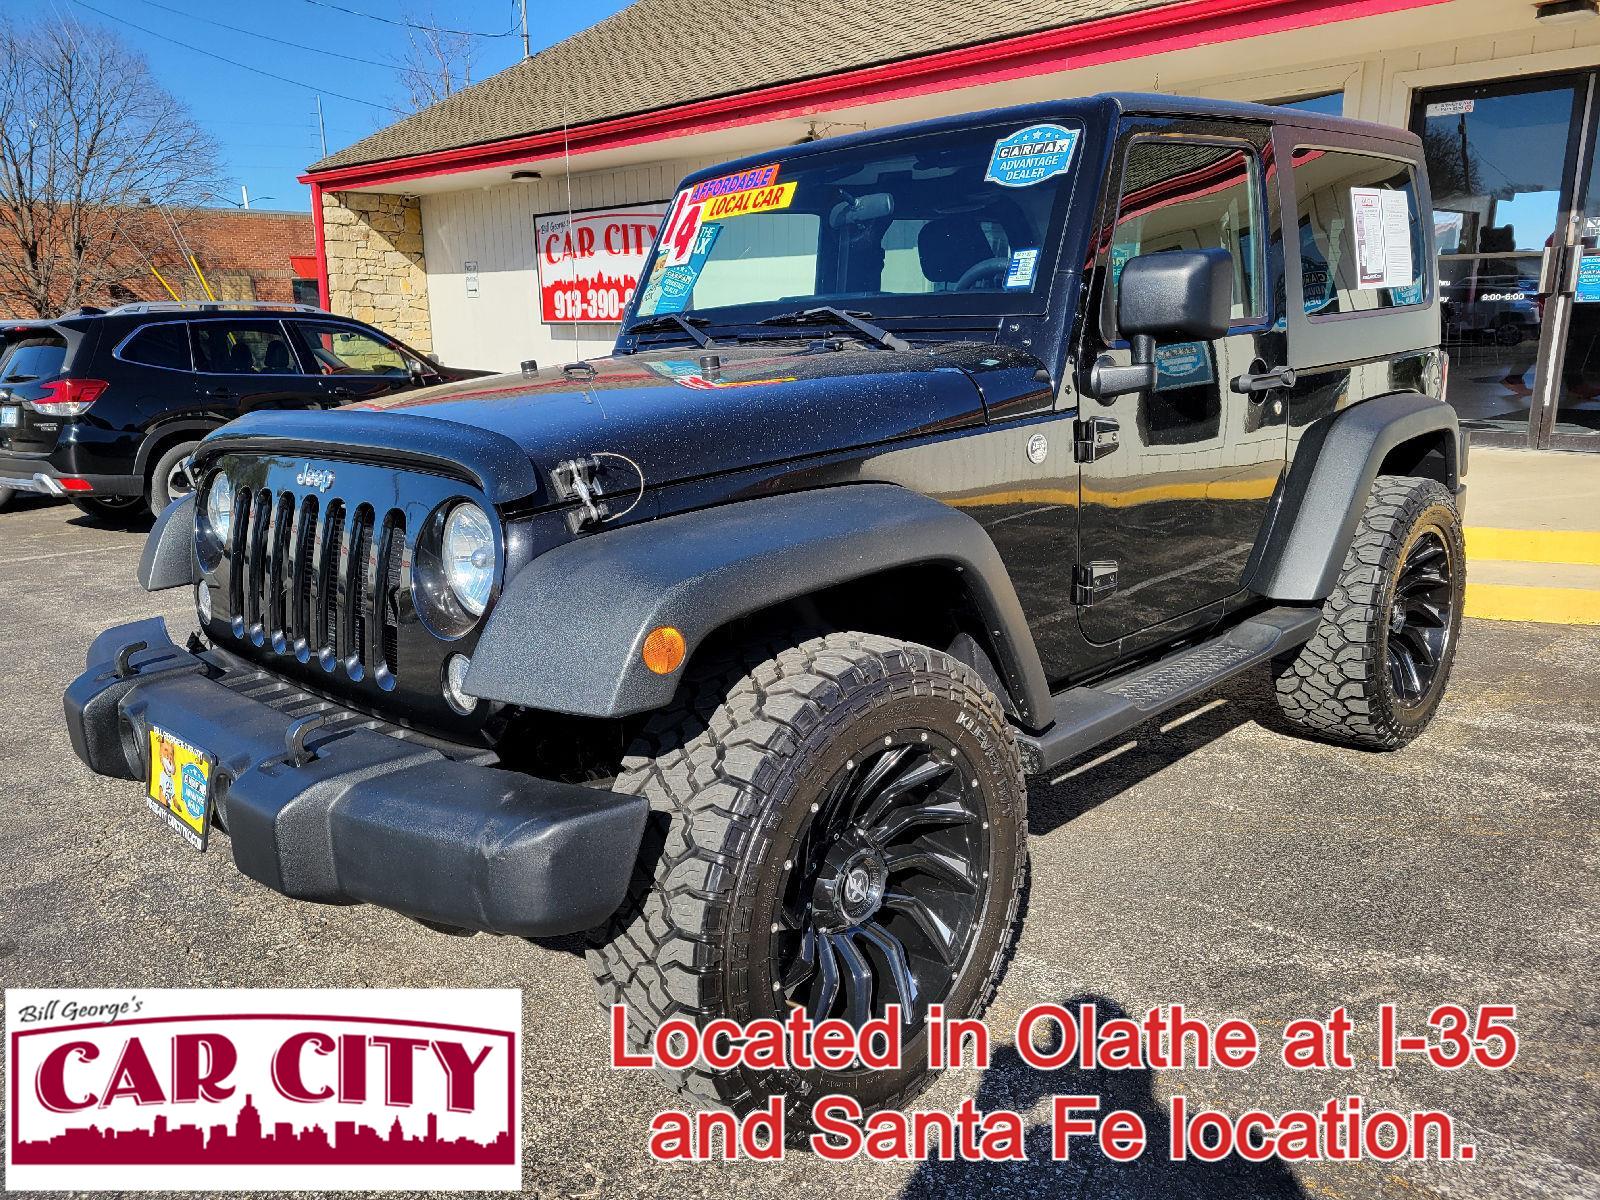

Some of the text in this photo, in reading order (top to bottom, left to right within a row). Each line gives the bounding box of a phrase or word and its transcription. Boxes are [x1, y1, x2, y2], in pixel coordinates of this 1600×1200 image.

[1000, 141, 1068, 158] CARFAX
[1000, 155, 1058, 170] ADVANTAGE
[692, 168, 773, 200] AFFORDABLE
[1006, 168, 1045, 180] DEALER
[709, 187, 784, 216] LOCAL CAR
[663, 192, 700, 260] 14
[545, 226, 595, 265] CAR
[1481, 292, 1525, 301] 9:00-6:00
[296, 462, 335, 493] Jeep
